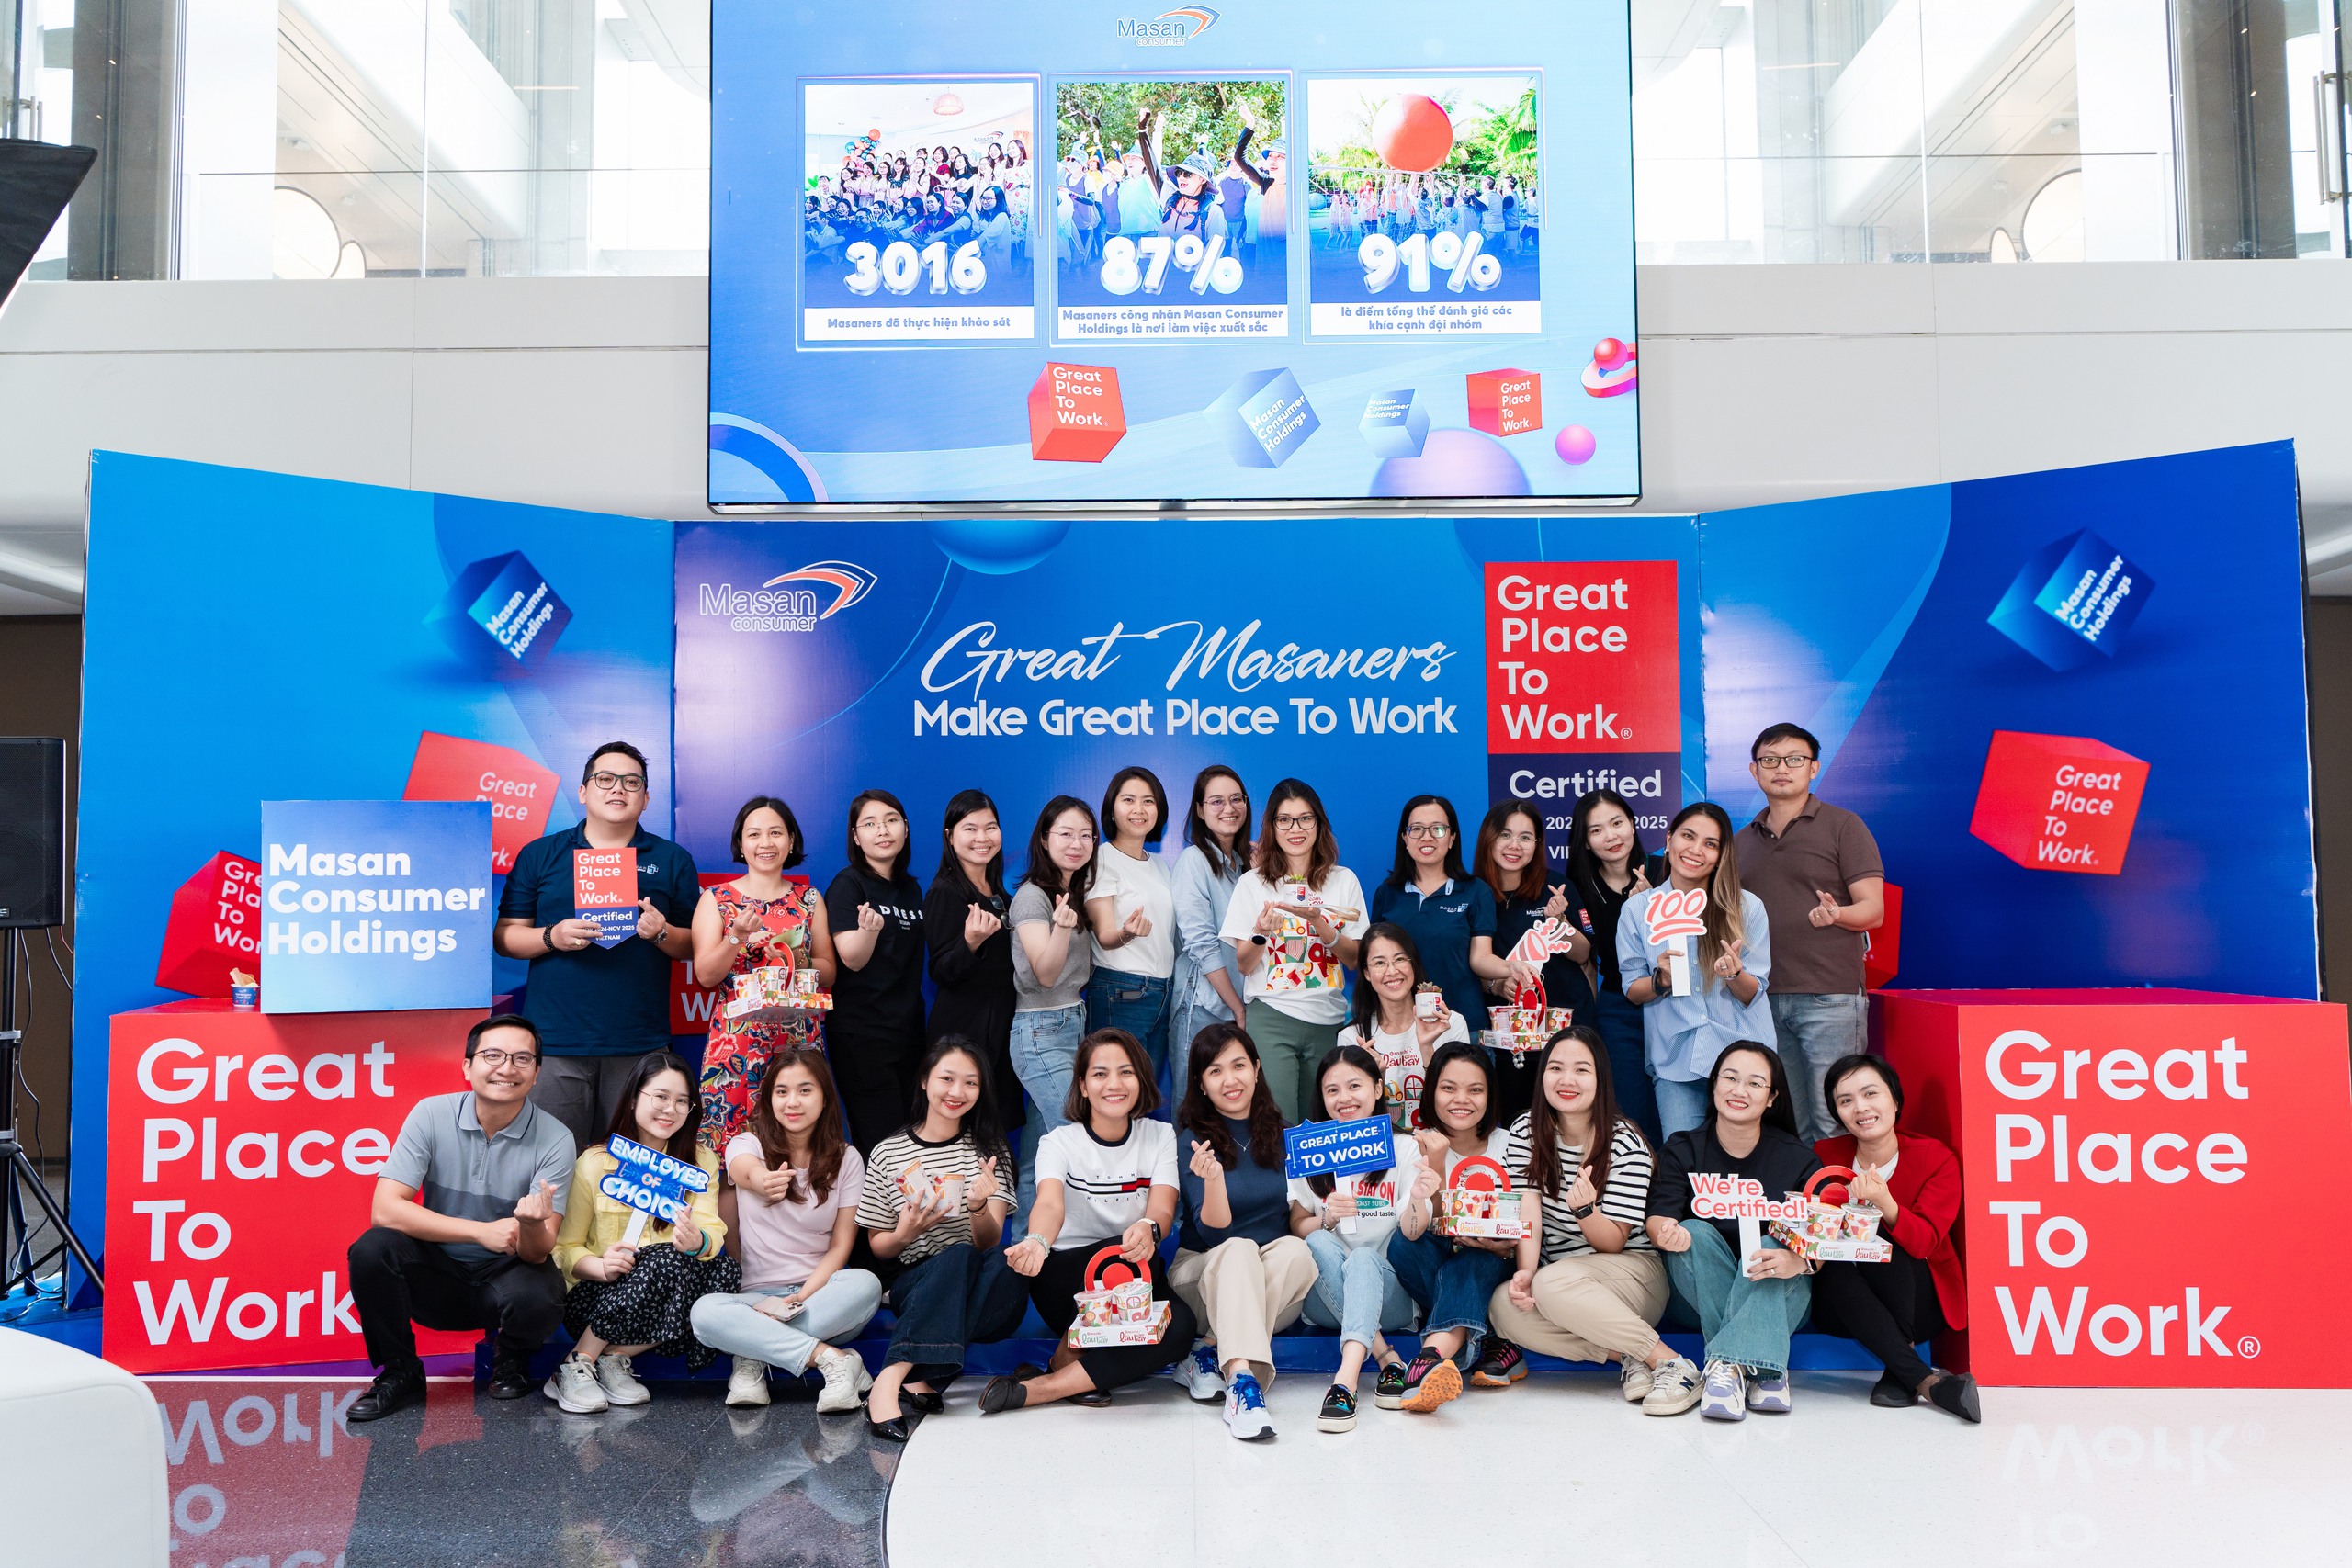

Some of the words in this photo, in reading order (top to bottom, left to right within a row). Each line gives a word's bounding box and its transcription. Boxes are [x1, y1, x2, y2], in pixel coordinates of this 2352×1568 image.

[1117, 18, 1185, 38] Masan
[1135, 37, 1186, 47] consumer
[842, 240, 987, 296] 3016
[1101, 233, 1244, 296] 87%
[1358, 231, 1502, 294] 91%
[828, 318, 882, 328] Masaners
[886, 318, 900, 328] đã
[903, 318, 930, 331] thực
[933, 318, 958, 330] hiện
[961, 317, 989, 327] khảo
[993, 317, 1011, 327] sát
[1063, 310, 1117, 320] Masaners
[1121, 310, 1148, 321] công
[1152, 310, 1181, 321] nhận
[1184, 309, 1221, 319] Masan
[1225, 309, 1283, 319] Consumer
[1341, 307, 1351, 316] là
[1355, 305, 1384, 316] điểm
[1387, 305, 1413, 318] tổng
[1417, 304, 1435, 316] thể
[1439, 305, 1467, 316] đánh
[1471, 306, 1488, 317] giá
[1492, 306, 1512, 315] các
[1079, 323, 1128, 334] Holdings
[1132, 323, 1142, 333] là
[1146, 322, 1164, 333] nơi
[1169, 323, 1189, 333] làm
[1193, 321, 1216, 334] việc
[1220, 321, 1240, 332] xuất
[1244, 320, 1268, 332] sắc
[1369, 320, 1394, 330] khía
[1396, 320, 1424, 332] cạnh
[1429, 319, 1446, 332] đội
[1450, 320, 1482, 330] nhóm
[1053, 367, 1102, 382] Great
[1055, 380, 1102, 396] Place
[1500, 380, 1531, 394] Great
[1055, 395, 1075, 409] To
[1366, 403, 1410, 412] Consumer
[1369, 398, 1396, 406] Masan
[1501, 393, 1531, 406] Place
[1501, 408, 1514, 419] To
[1250, 398, 1285, 431] Masan
[1256, 394, 1306, 441] Consumer
[1364, 411, 1402, 419] Holdings
[1263, 411, 1306, 453] Holdings
[700, 583, 816, 615] Masan
[1497, 575, 1629, 611] Great
[2054, 570, 2098, 621] Masan
[2069, 555, 2123, 629] Consumer
[485, 591, 525, 636] Masan
[498, 581, 548, 645] Consumer
[2083, 575, 2132, 641] Holdings
[509, 602, 554, 659] Holdings
[731, 615, 817, 632] consumer
[1502, 617, 1628, 653] Place
[920, 621, 1124, 702] Great
[1143, 619, 1457, 693] Masaners
[1498, 661, 1549, 695] To
[914, 699, 1028, 736] Make
[1039, 698, 1153, 736] Great
[1167, 698, 1280, 735] Place
[1289, 698, 1337, 735] To
[1348, 697, 1458, 734] Work
[479, 772, 537, 798] Great
[1509, 769, 1662, 798] Certified
[2055, 764, 2122, 791] Great
[475, 795, 529, 821] ace
[2049, 790, 2114, 816] Place
[1545, 816, 1572, 830] 202
[2044, 816, 2067, 837] To
[268, 843, 411, 877] Masan
[578, 852, 621, 864] Great
[579, 865, 621, 877] Place
[224, 861, 262, 889] Gre
[579, 879, 595, 890] To
[221, 879, 262, 908] Pla
[267, 879, 486, 914] Consumer
[1646, 890, 1704, 923] 100
[217, 900, 244, 925] To
[582, 911, 633, 922] Certified
[214, 922, 262, 954] Wor
[268, 919, 458, 962] Holdings
[137, 1038, 395, 1104] Great
[1985, 1030, 2249, 1100] Great
[141, 1117, 395, 1183] Place
[1299, 1134, 1338, 1149] GREAT
[1340, 1126, 1378, 1142] PLACE
[1995, 1114, 2249, 1184] Place
[609, 1136, 708, 1190] EMPLOYER
[1301, 1154, 1325, 1168] TO
[1329, 1141, 1385, 1163] WORK
[641, 1172, 662, 1188] OF
[1691, 1176, 1760, 1195] We're
[1693, 1197, 1806, 1219] Certified!
[133, 1199, 232, 1262] To
[1989, 1201, 2088, 1268] To
[133, 1271, 365, 1346] Work
